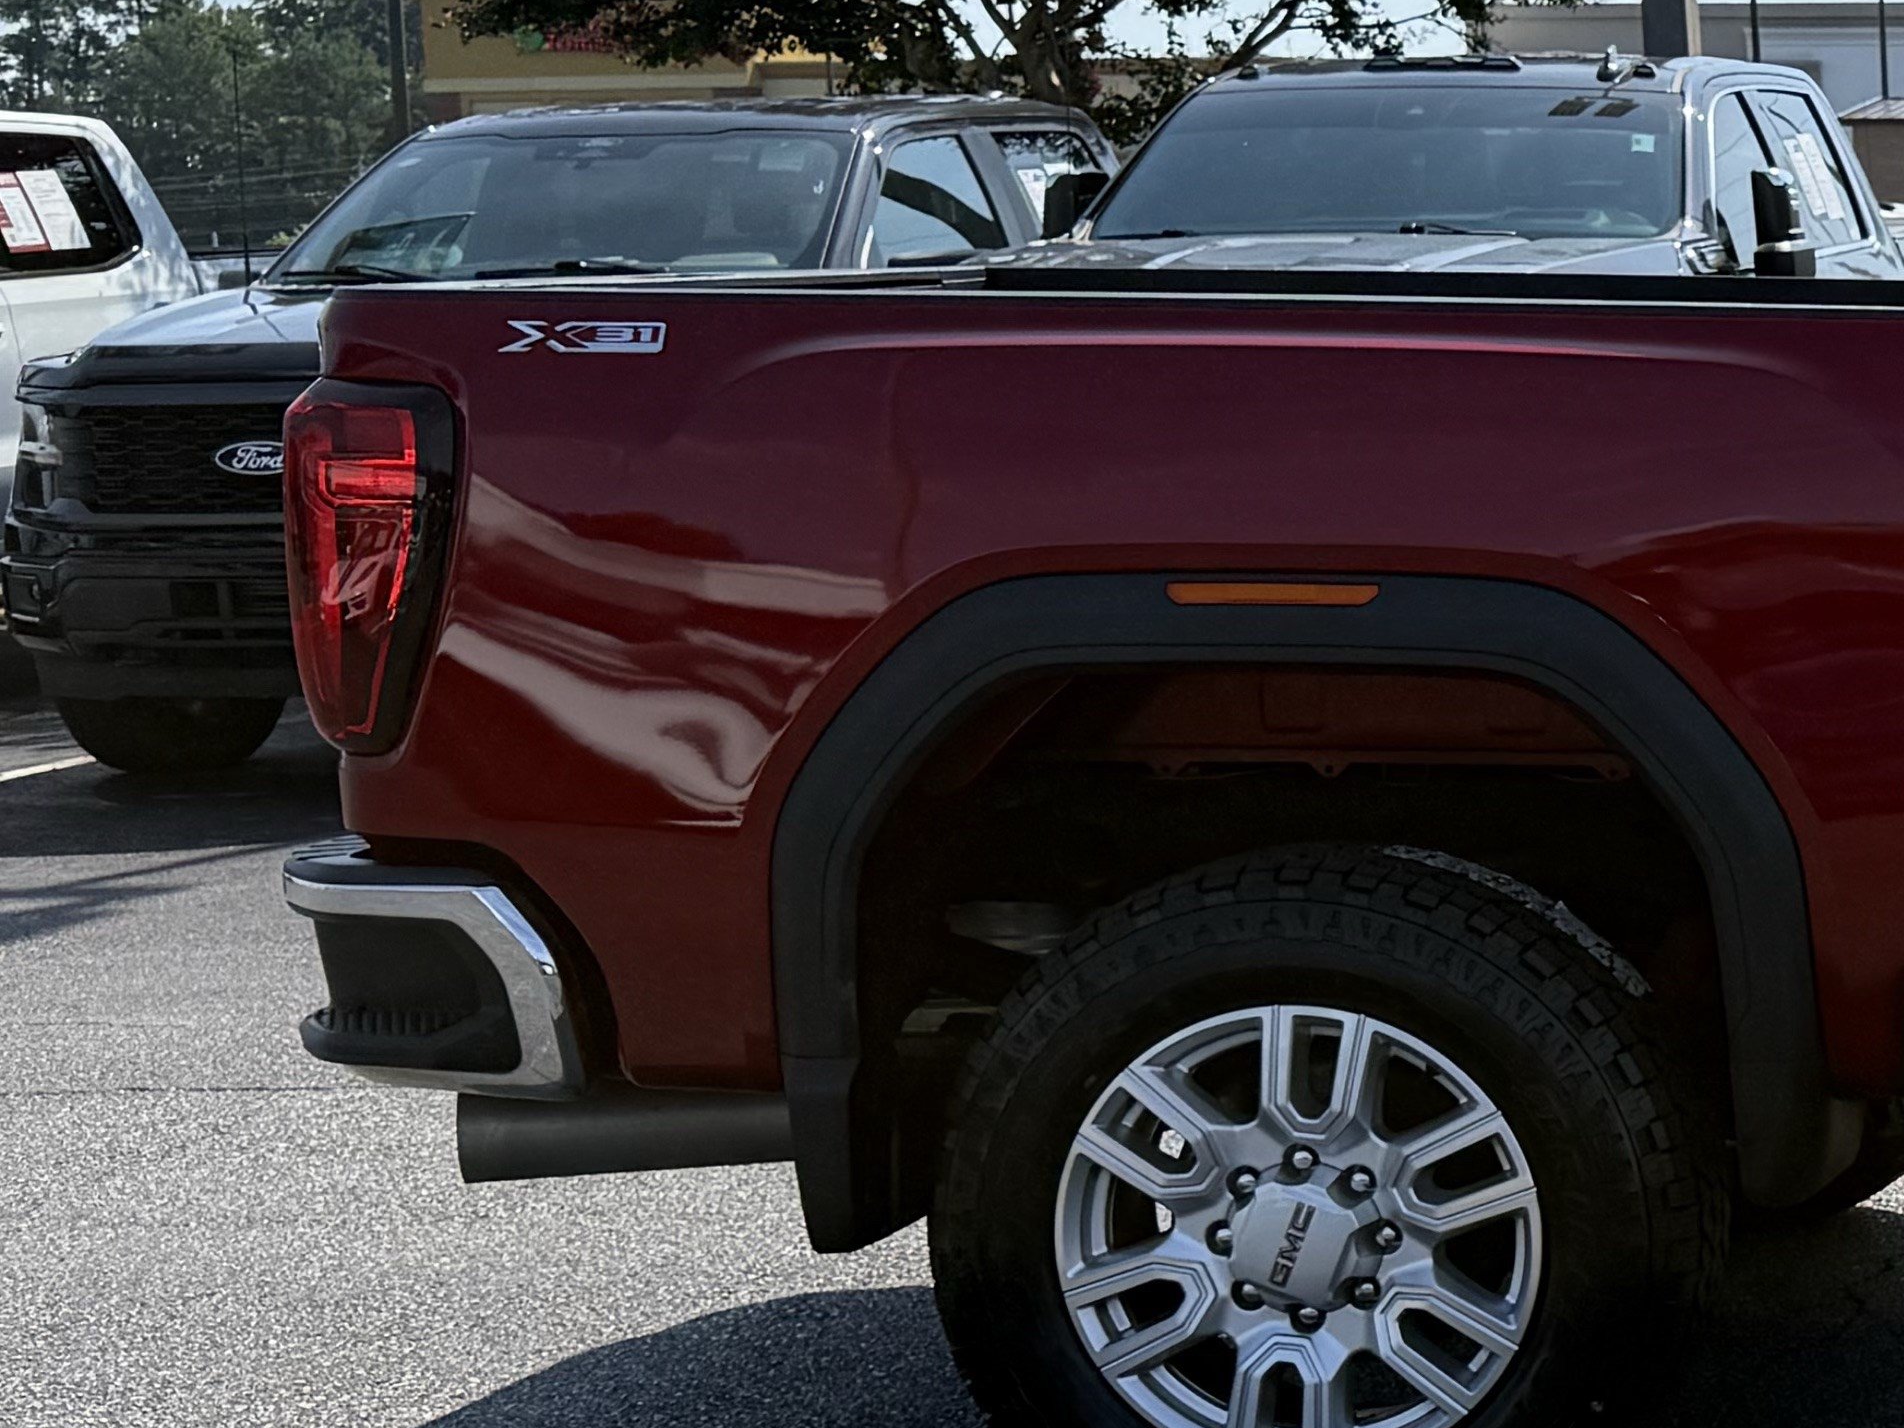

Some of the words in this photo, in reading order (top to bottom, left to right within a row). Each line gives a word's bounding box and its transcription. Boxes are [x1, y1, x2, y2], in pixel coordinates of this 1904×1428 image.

[498, 320, 667, 353] X31
[232, 446, 284, 469] Ford
[1267, 1201, 1317, 1288] GMC
